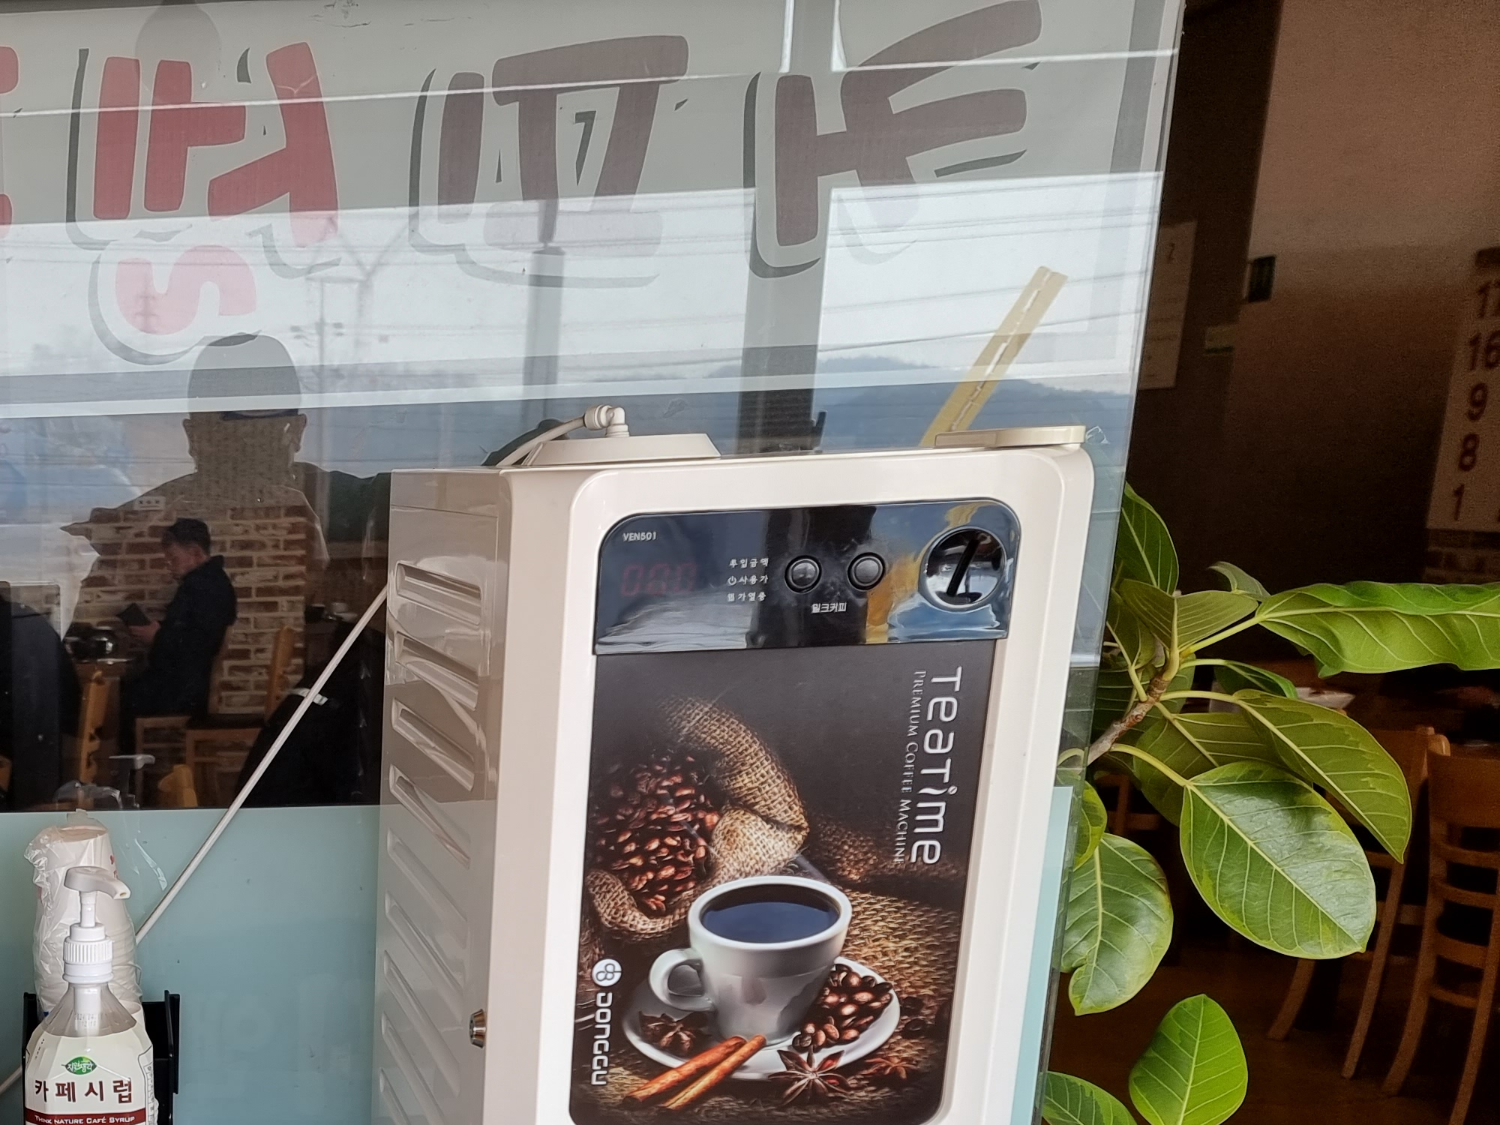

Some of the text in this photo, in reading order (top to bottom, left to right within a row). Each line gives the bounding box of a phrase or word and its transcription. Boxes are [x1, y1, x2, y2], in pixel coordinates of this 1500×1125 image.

[1466, 382, 1487, 421] 9
[1458, 433, 1478, 472] 8
[1451, 483, 1464, 521] 1
[622, 531, 657, 542] VEN501
[810, 601, 847, 614] 밀크커피
